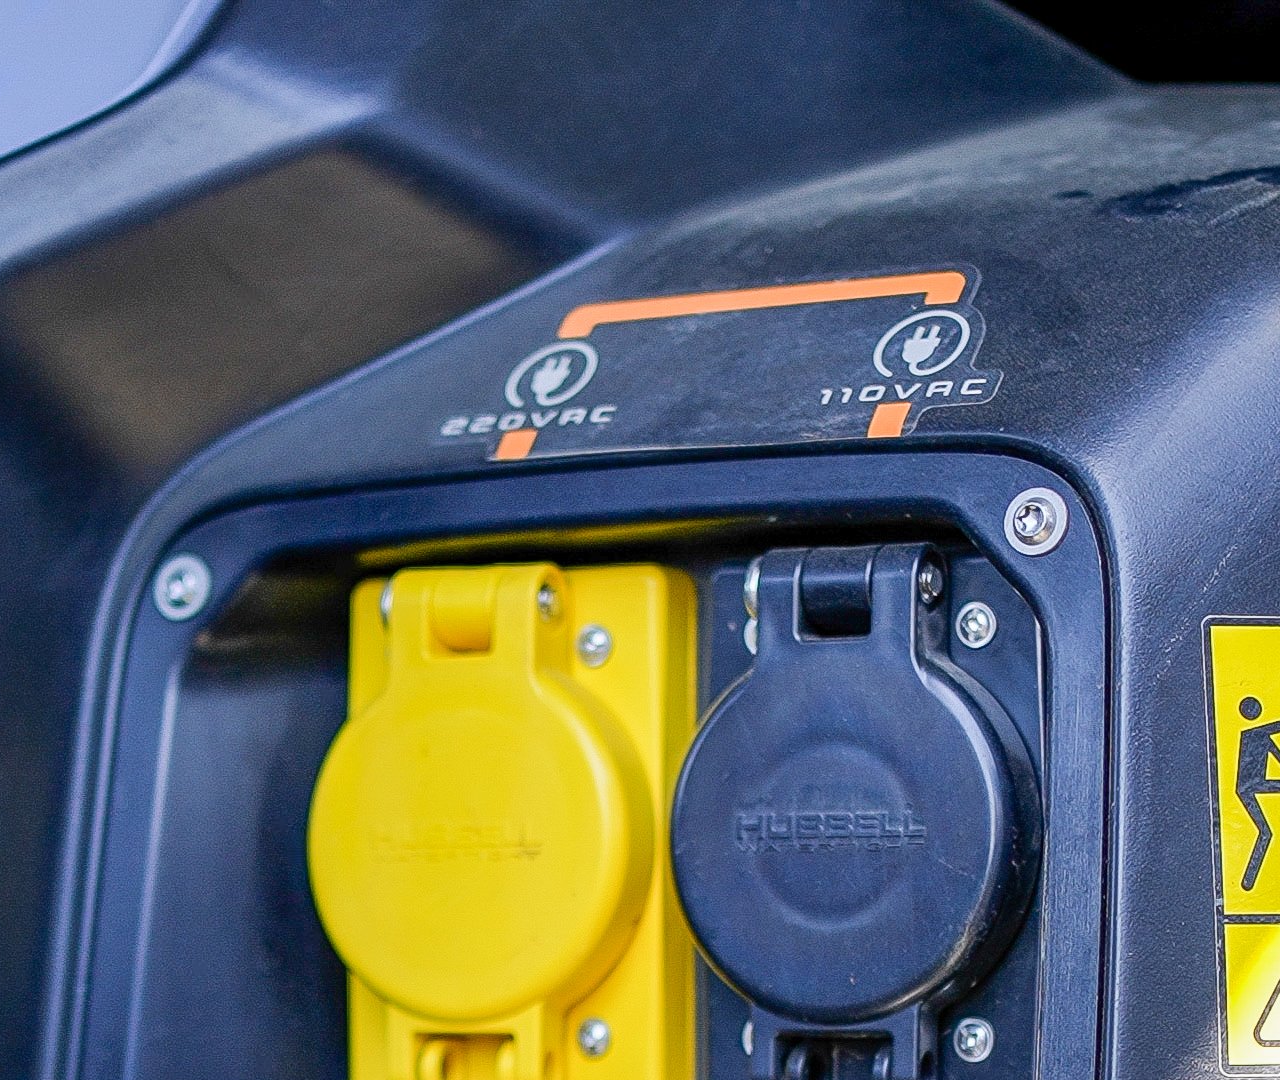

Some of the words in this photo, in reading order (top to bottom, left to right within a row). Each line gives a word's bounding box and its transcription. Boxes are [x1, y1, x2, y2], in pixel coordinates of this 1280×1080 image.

[821, 378, 987, 405] 110VAC
[440, 404, 618, 436] 220VAC
[734, 809, 927, 840] HUBBELL
